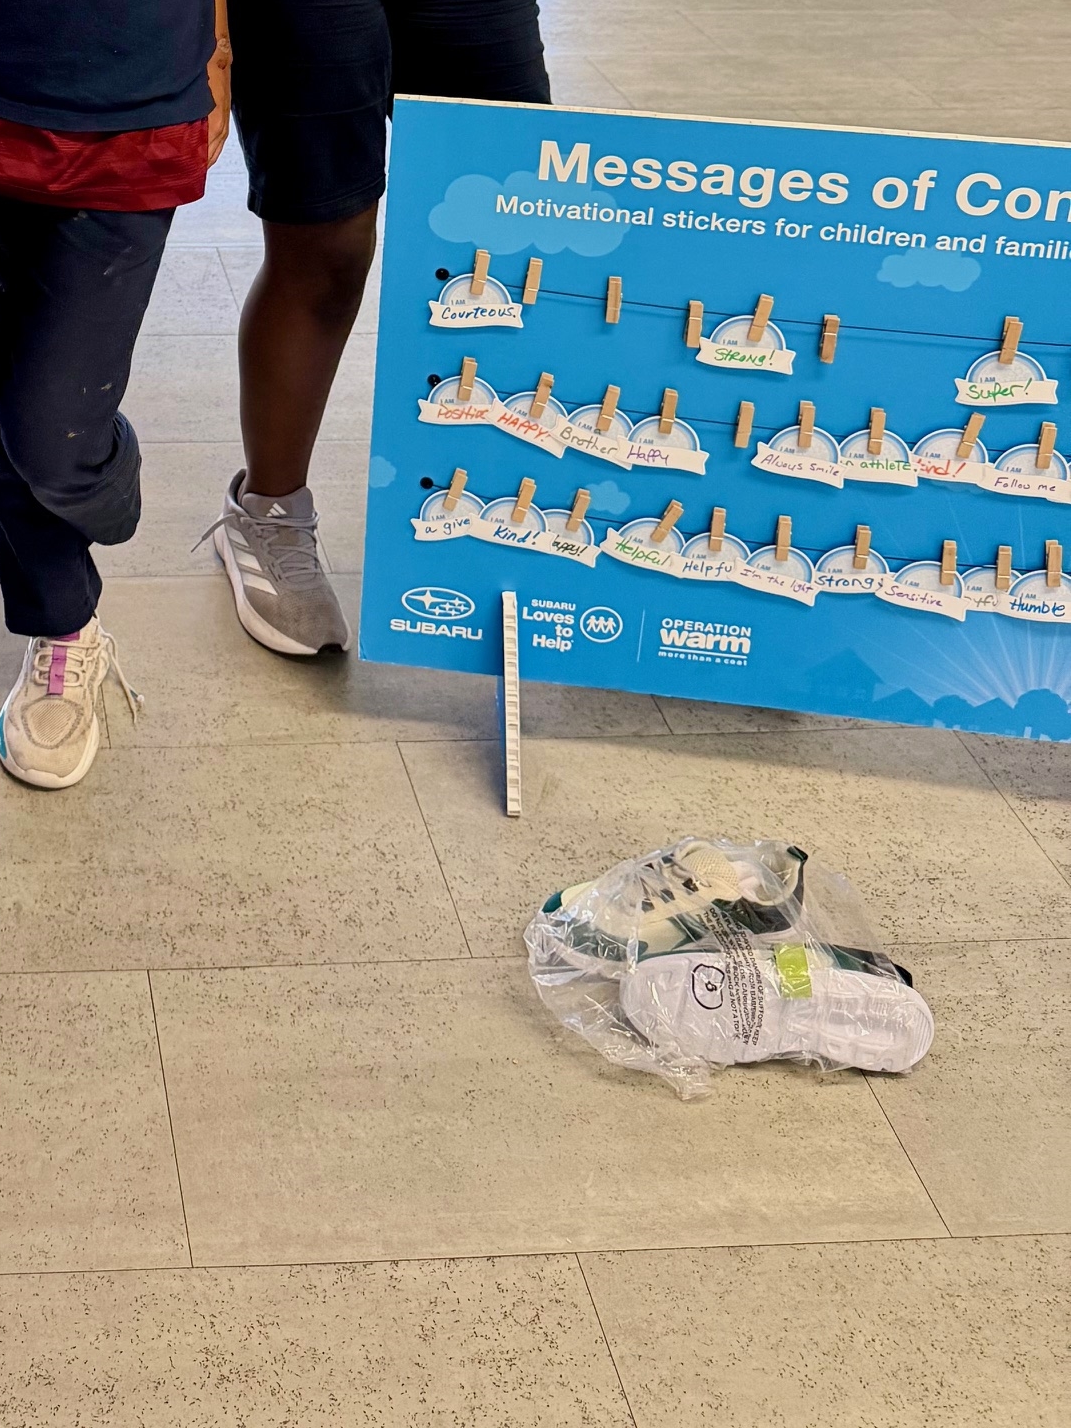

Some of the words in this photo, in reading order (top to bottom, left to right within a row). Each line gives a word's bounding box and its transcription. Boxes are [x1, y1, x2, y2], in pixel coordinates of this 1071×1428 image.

[538, 140, 849, 208] Messages
[872, 169, 938, 211] of
[495, 194, 654, 225] Motivational
[662, 211, 766, 235] stickers
[775, 218, 813, 239] for
[819, 222, 926, 249] children
[935, 234, 986, 253] and
[995, 236, 1071, 260] famili
[560, 426, 618, 454] Brother
[994, 476, 1030, 490] Follow
[1038, 483, 1056, 492] me
[425, 524, 436, 534] a
[493, 525, 541, 546] Kind!
[615, 537, 670, 567] Helpful
[766, 576, 785, 587] the
[790, 578, 814, 594] light
[531, 599, 576, 611] SUBARU
[884, 585, 943, 607] Sensitive
[522, 607, 574, 624] Loves
[390, 619, 483, 640] SUBARU
[555, 624, 573, 637] to
[662, 618, 751, 637] OPERATION
[532, 634, 572, 652] Help
[660, 628, 751, 654] warm
[658, 651, 685, 660] more
[688, 653, 711, 663] than
[724, 658, 747, 666] coat
